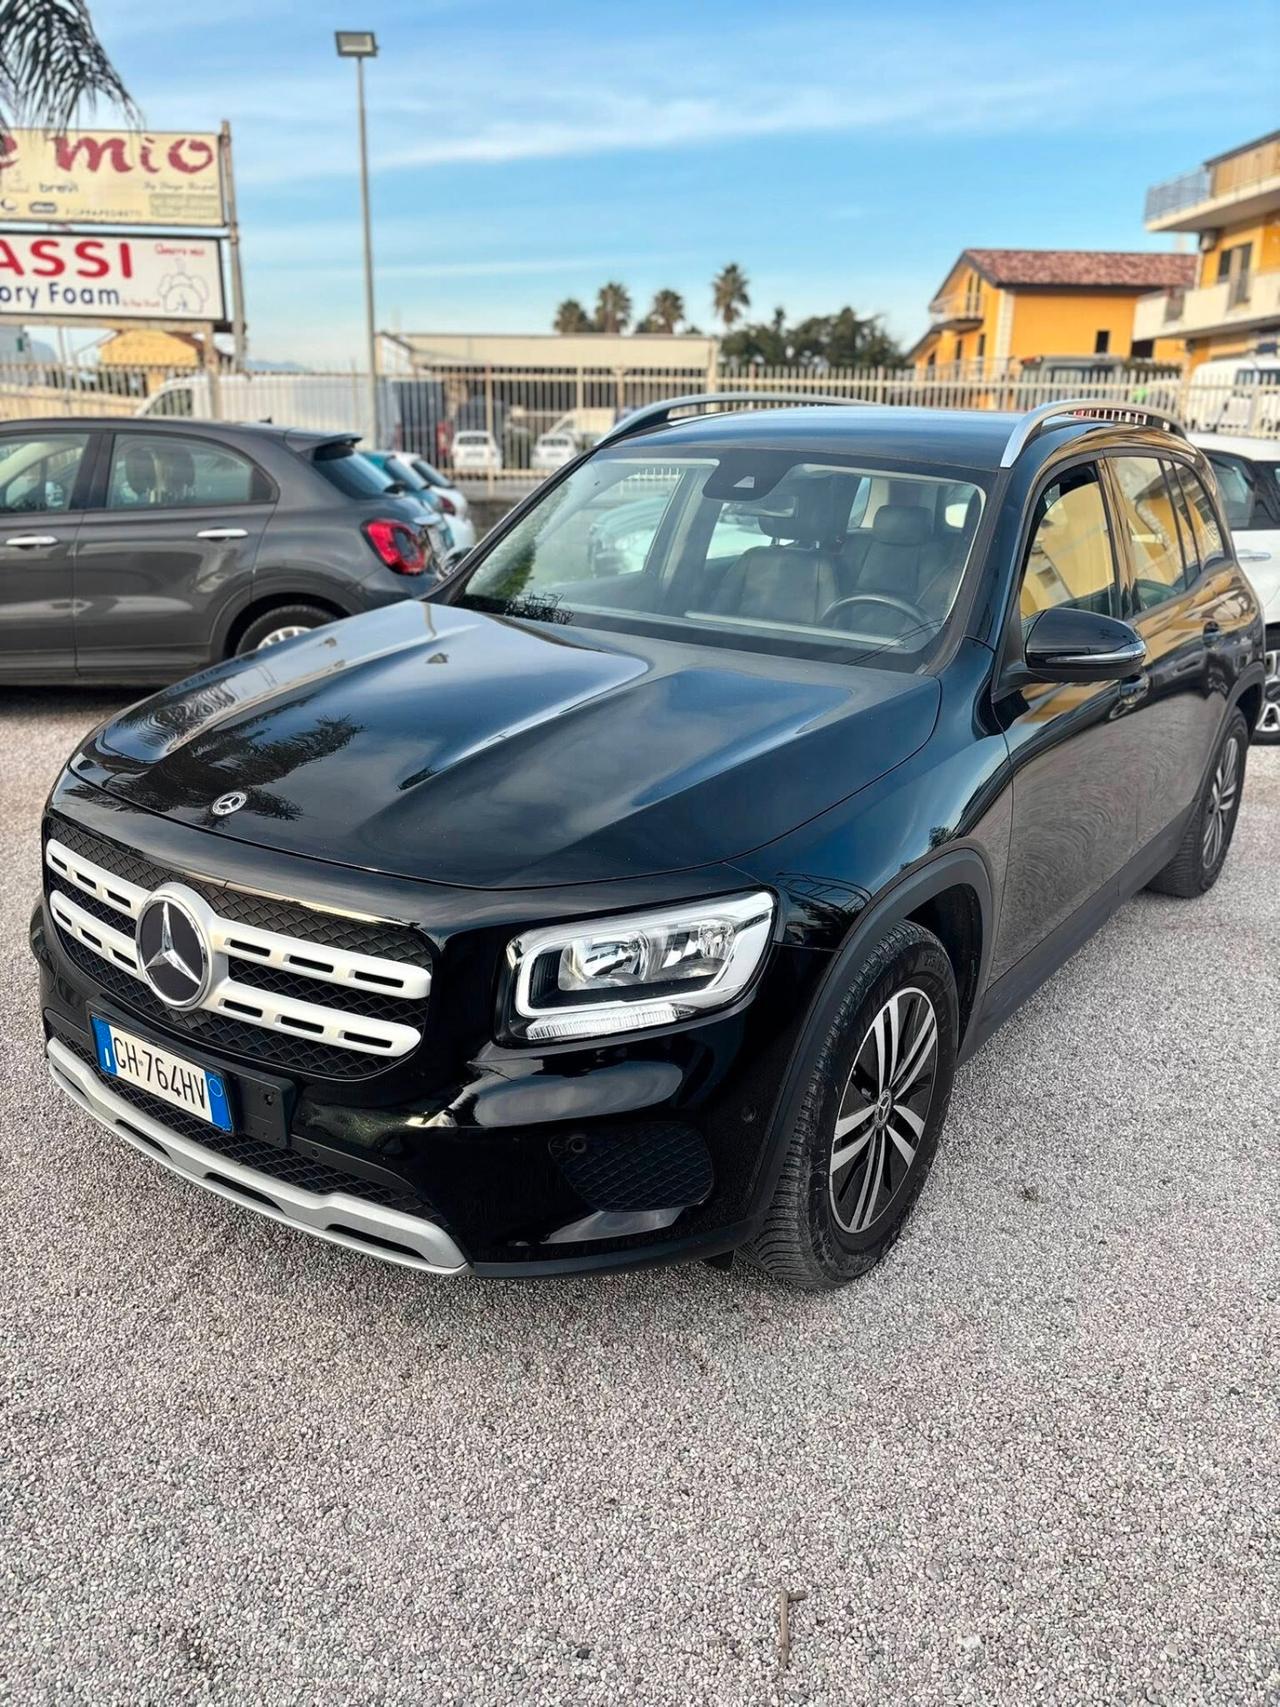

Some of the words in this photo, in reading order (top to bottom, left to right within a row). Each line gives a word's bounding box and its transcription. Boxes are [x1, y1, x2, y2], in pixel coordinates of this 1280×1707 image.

[47, 136, 214, 174] mio
[0, 240, 132, 279] ASSI
[48, 282, 120, 305] Foam
